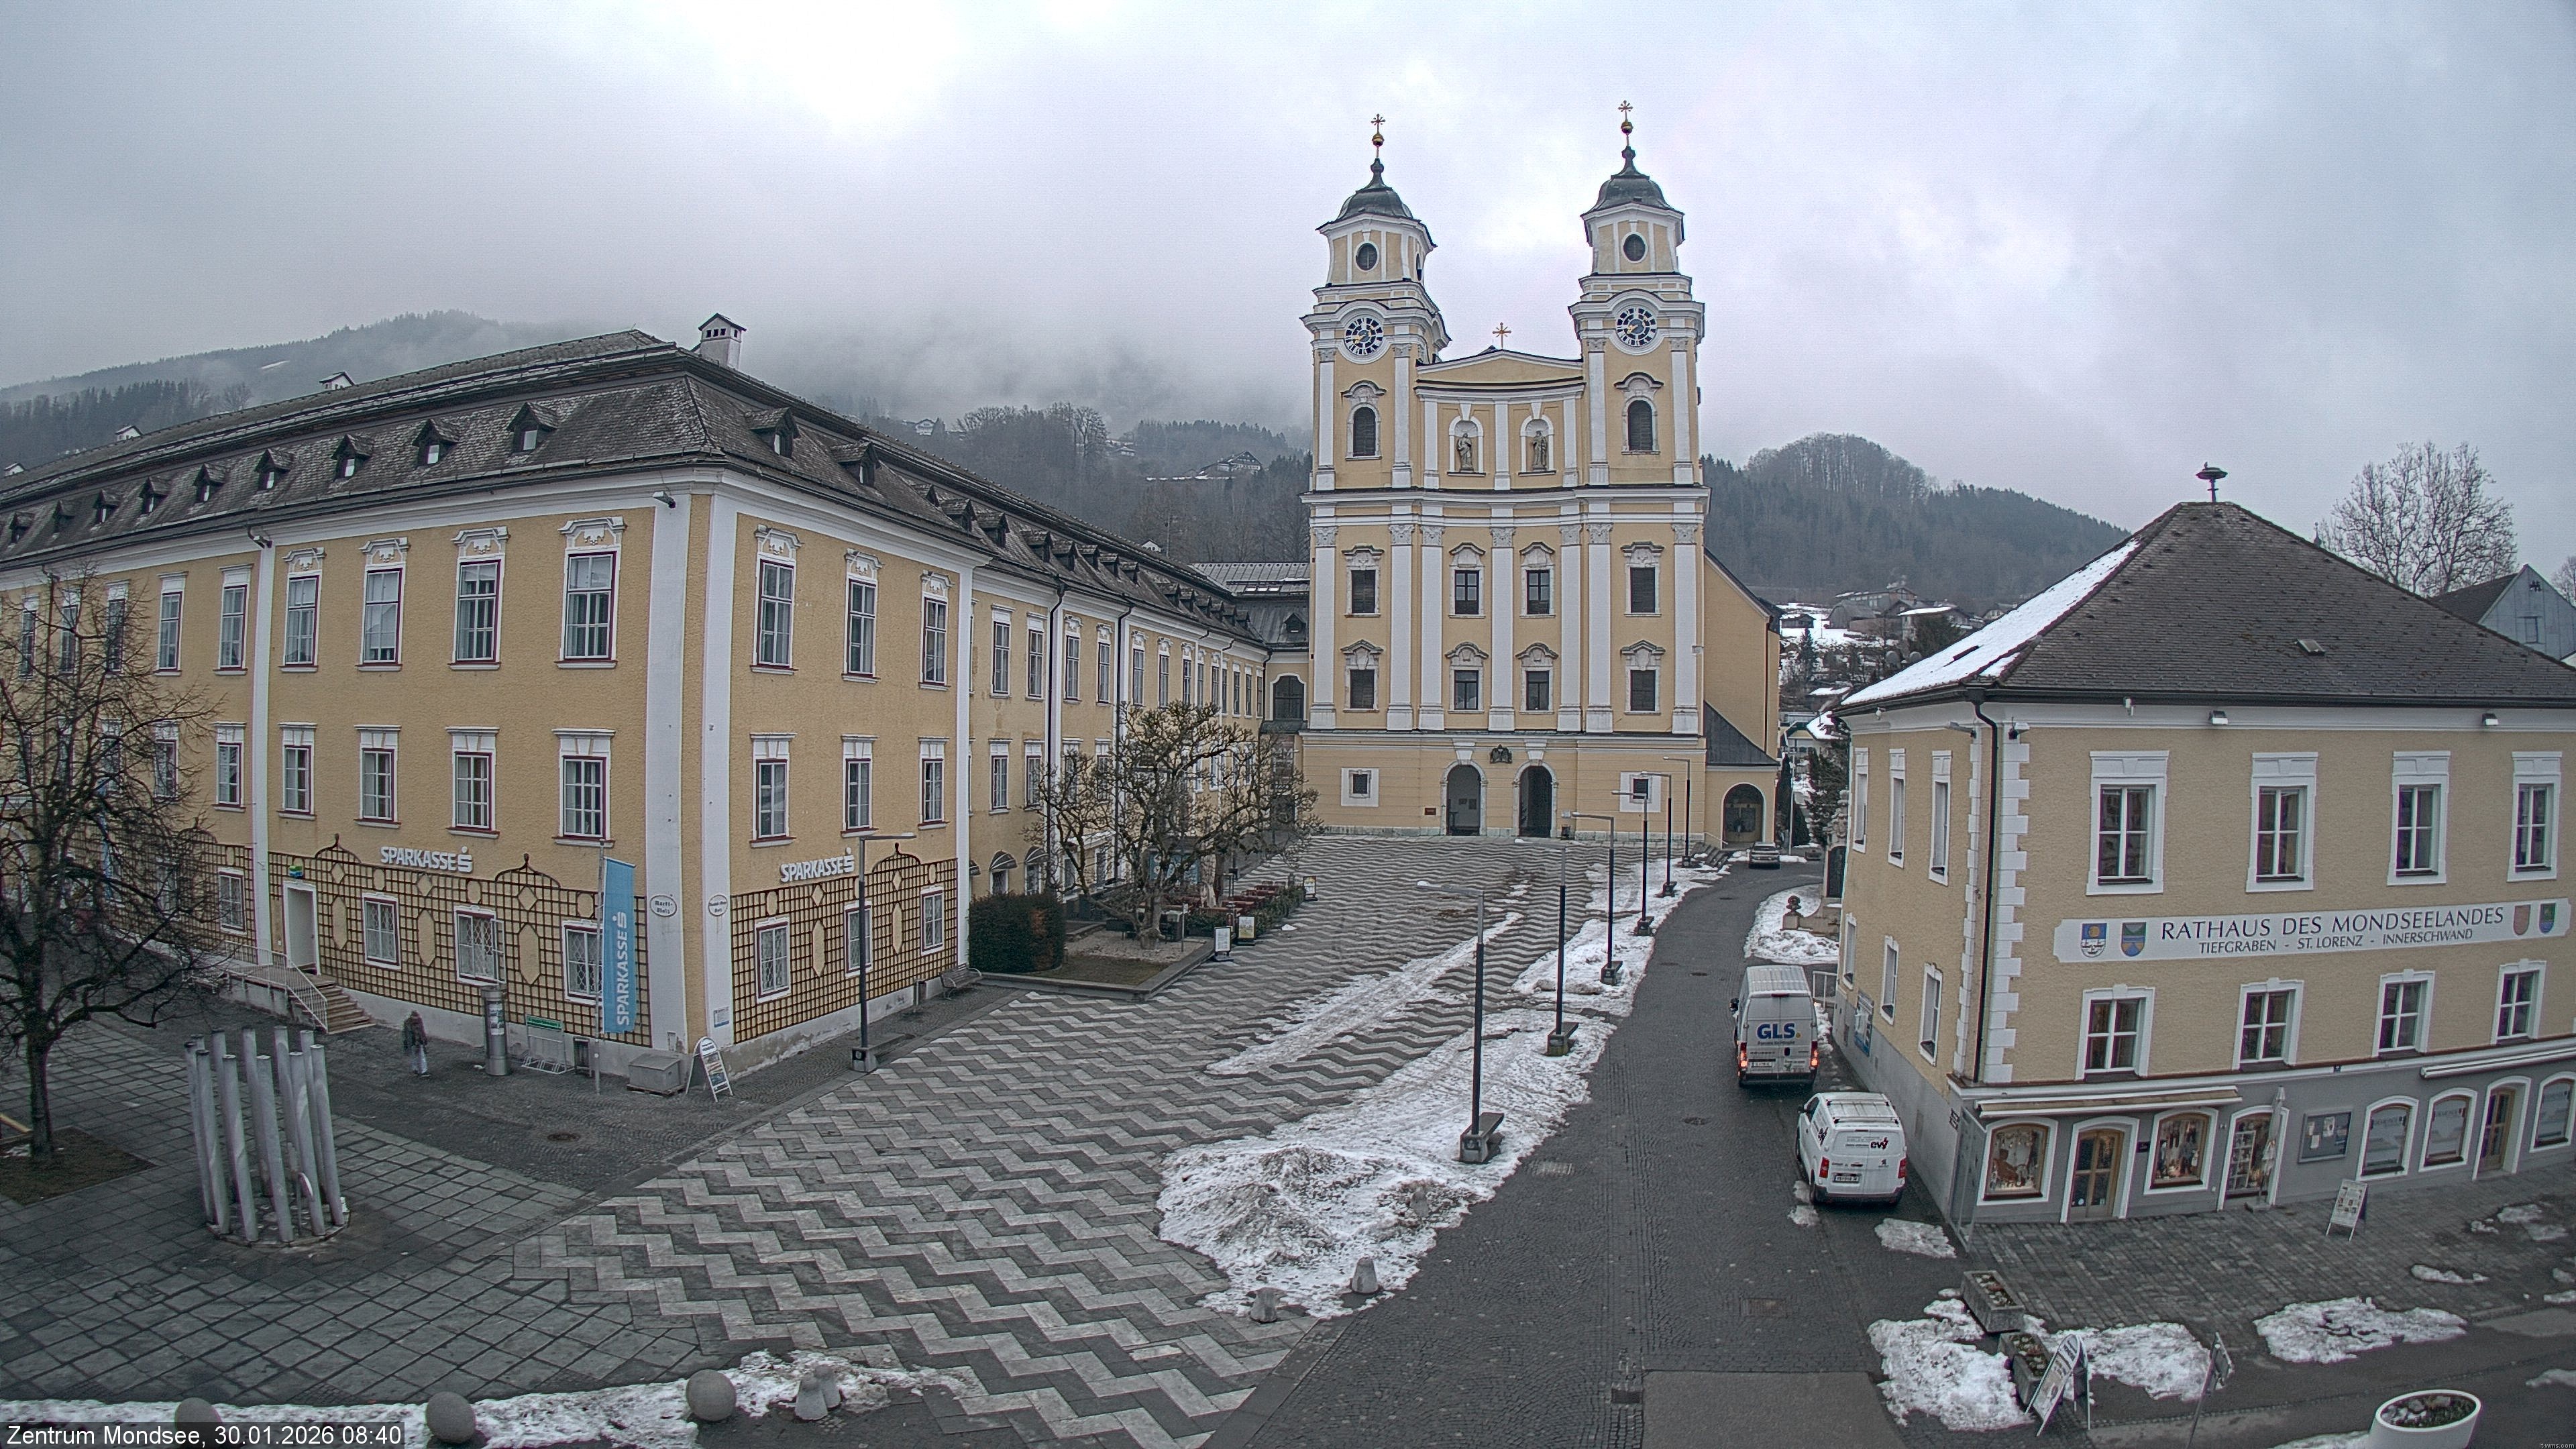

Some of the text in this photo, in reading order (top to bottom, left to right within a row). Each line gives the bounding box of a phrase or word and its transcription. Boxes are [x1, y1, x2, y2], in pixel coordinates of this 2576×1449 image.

[380, 846, 457, 871] SPARKASSE
[780, 856, 844, 883] SPARKASSE
[2161, 906, 2504, 940] RATHAUS DES MONDSEELANDES
[2199, 939, 2277, 954] TIEFGRABEN
[2297, 937, 2313, 949] ST.
[2316, 934, 2363, 949] LORENZ
[2382, 928, 2473, 945] INNERSCHWAND
[616, 930, 629, 1026] SPARKASSE
